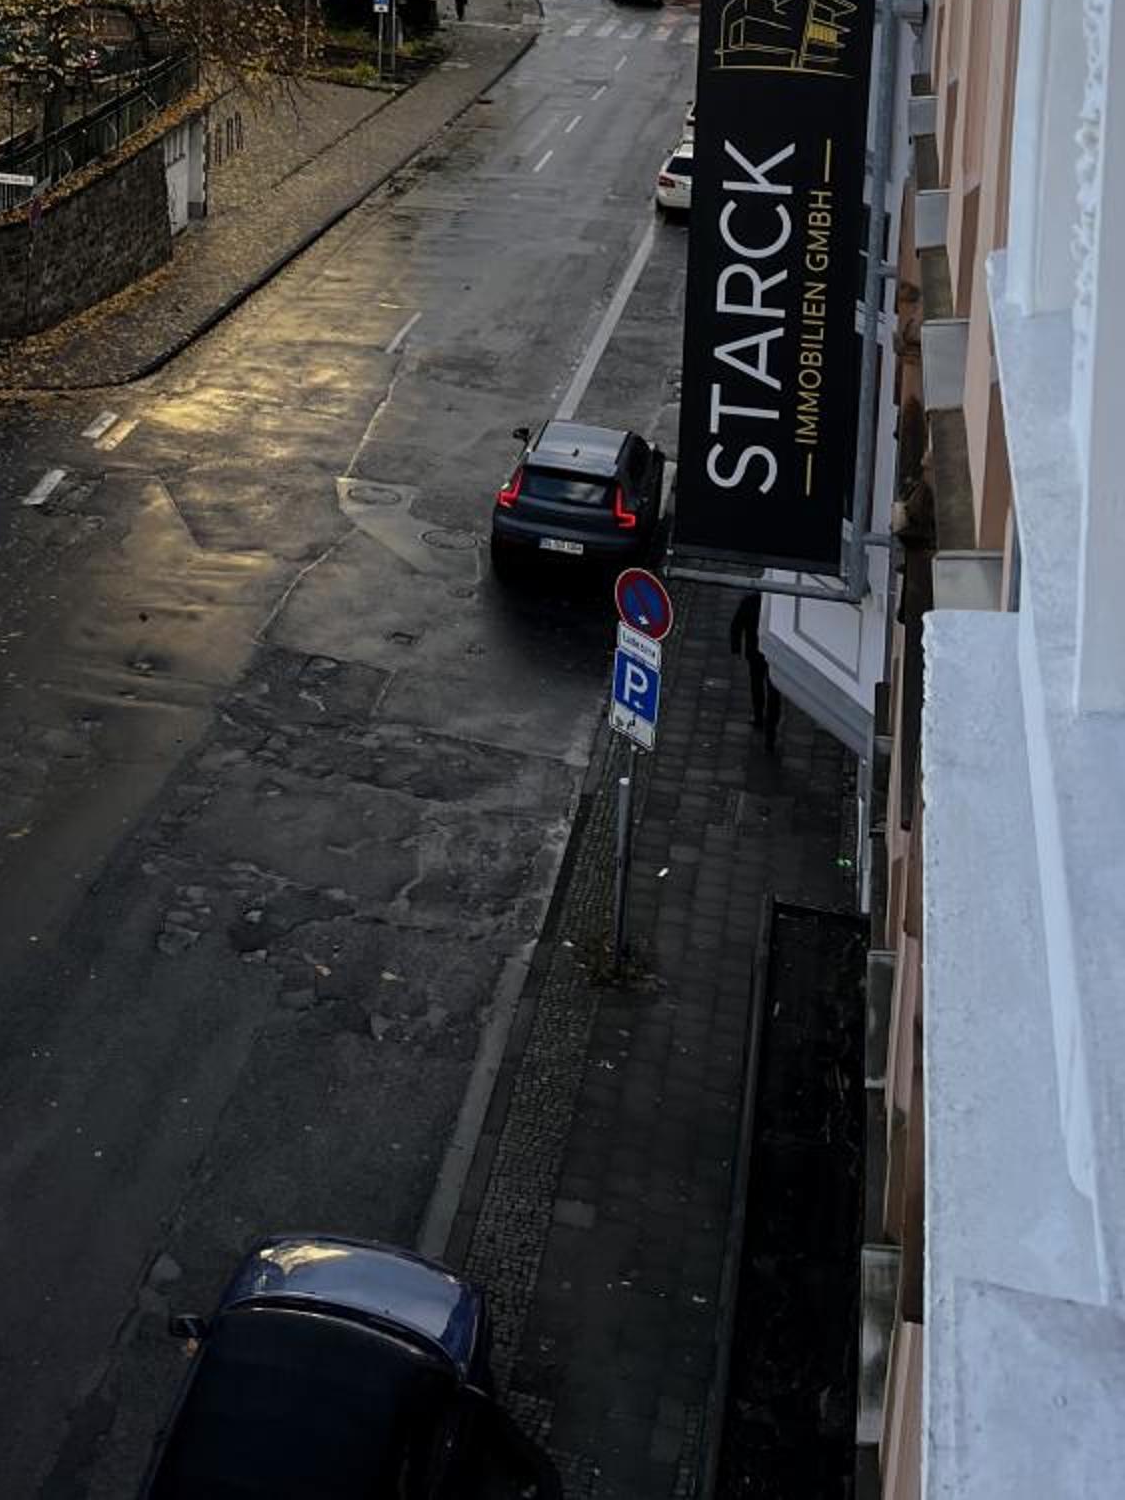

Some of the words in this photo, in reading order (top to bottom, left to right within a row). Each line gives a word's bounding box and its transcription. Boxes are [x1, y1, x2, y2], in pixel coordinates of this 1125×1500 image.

[806, 189, 833, 272] GMBH
[707, 140, 796, 494] STARCK
[795, 282, 827, 444] IMMOBILIEN
[623, 663, 648, 702] P
